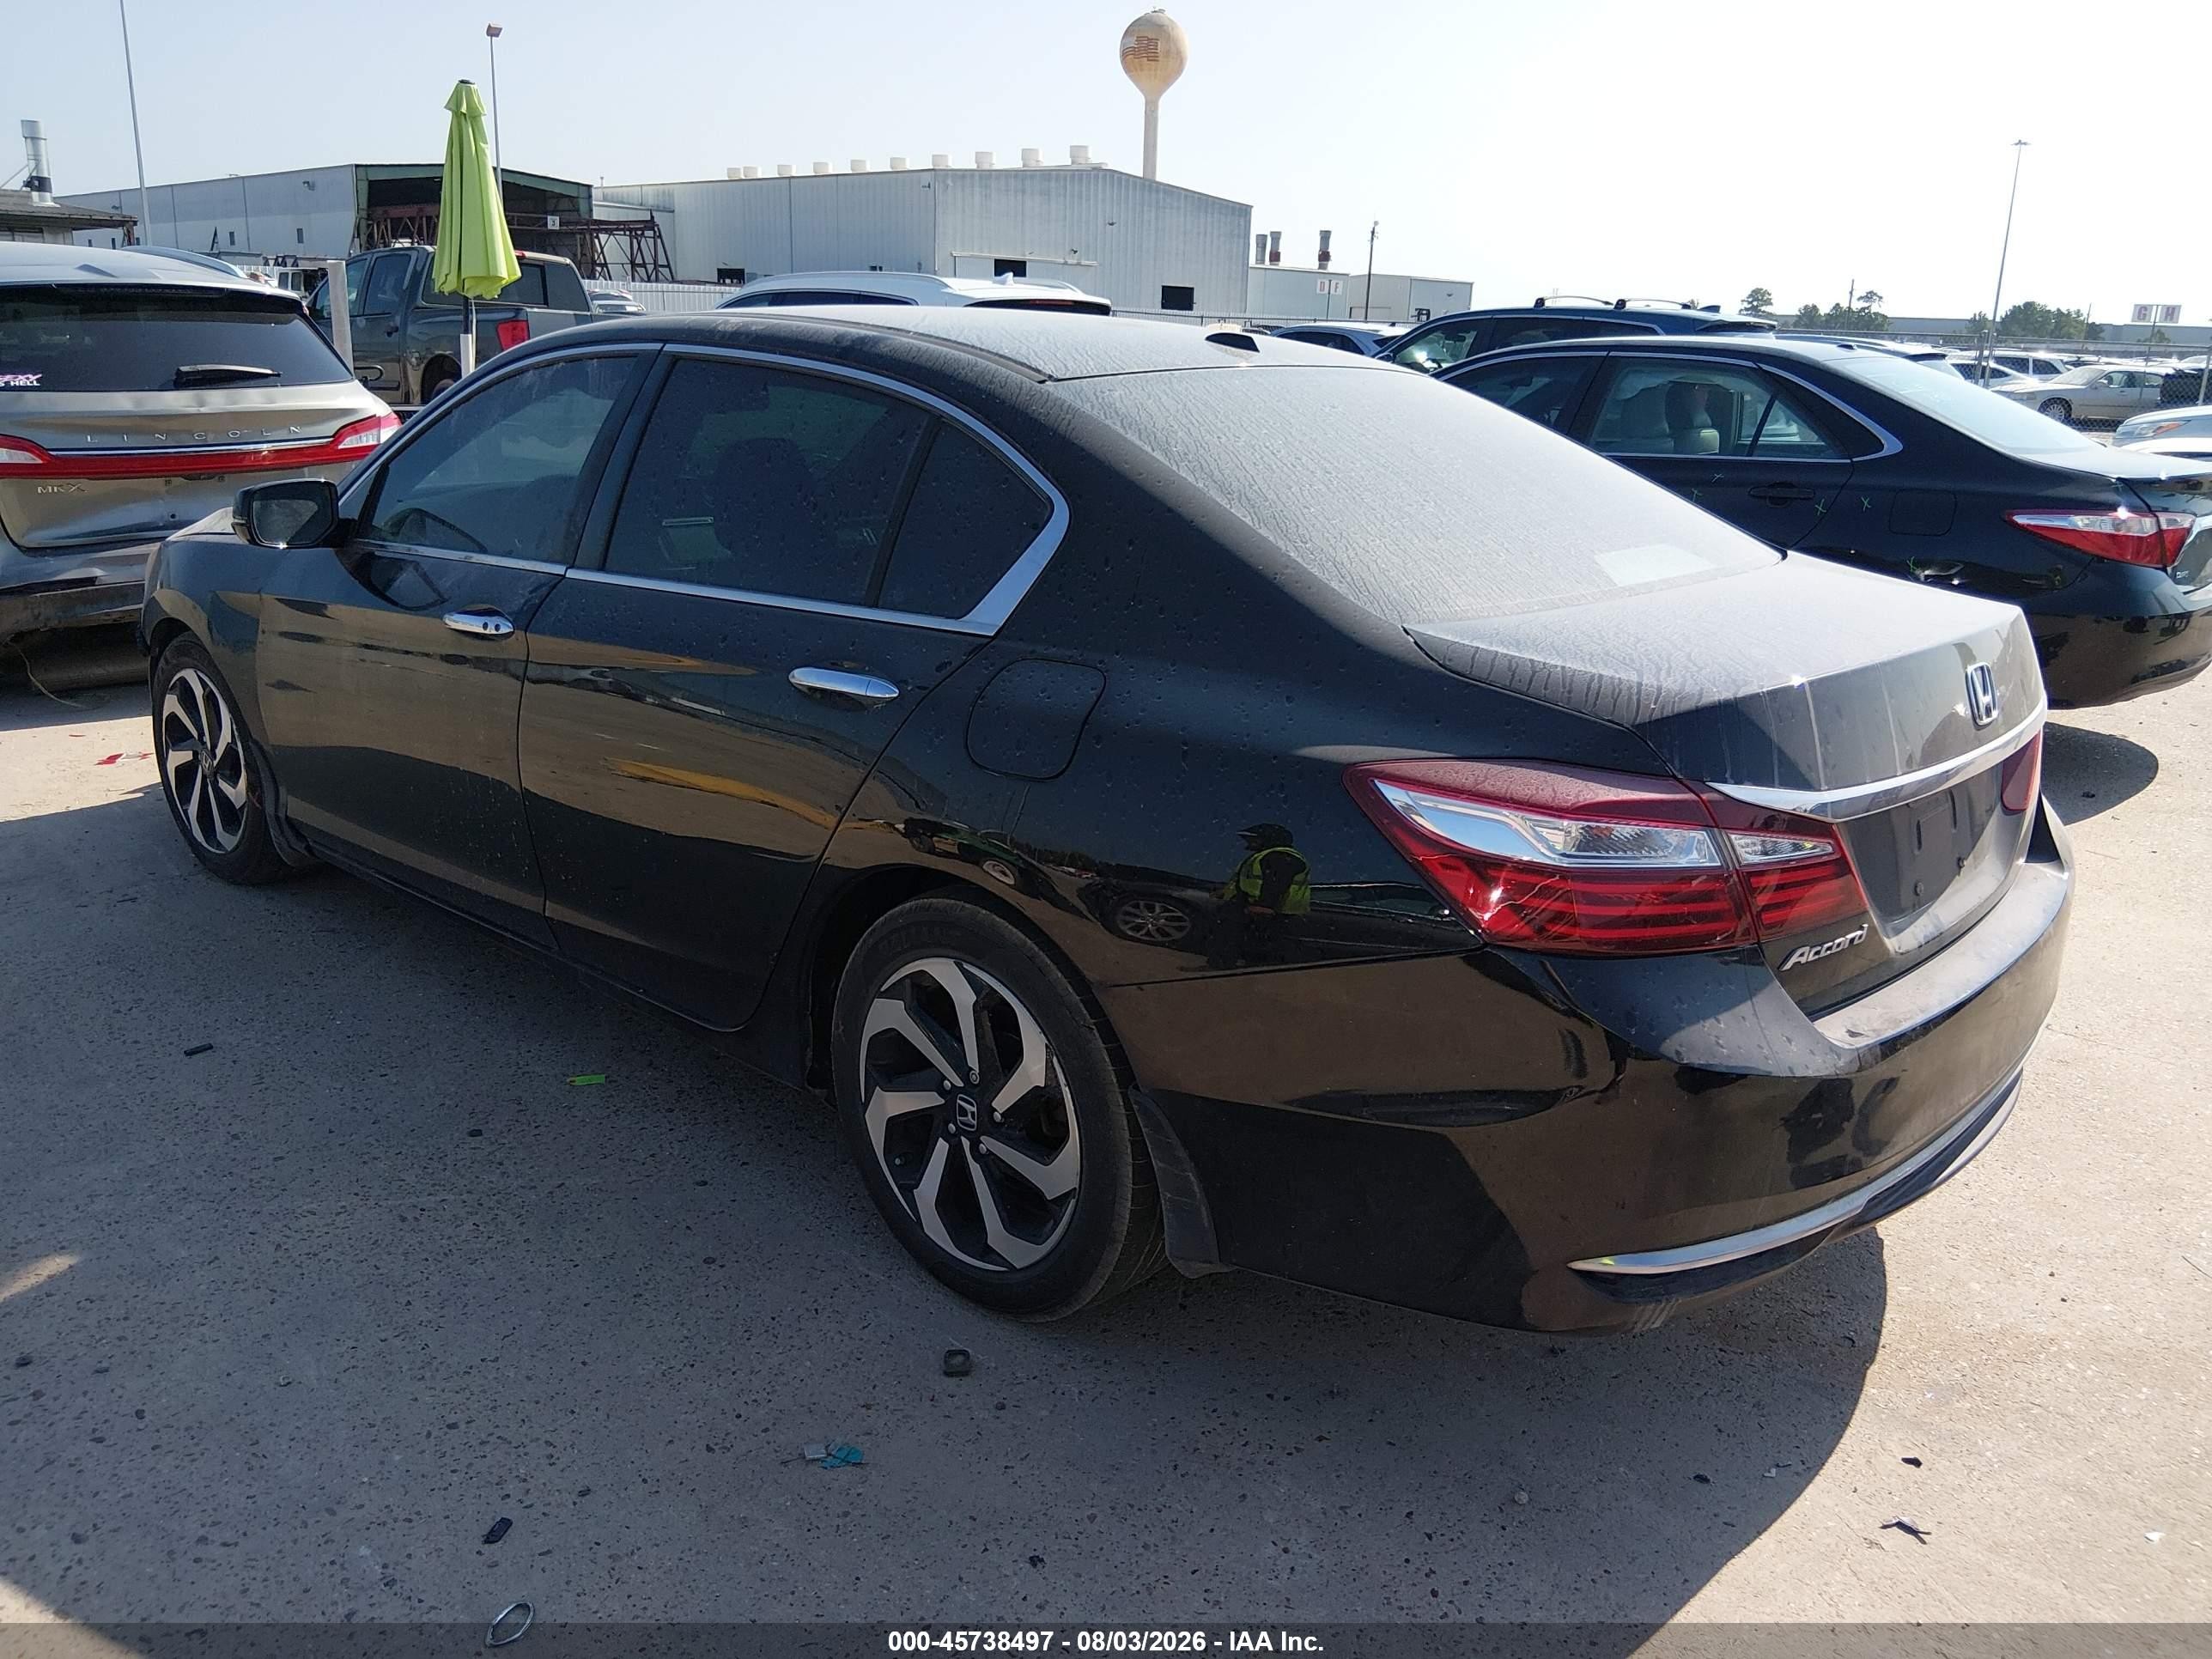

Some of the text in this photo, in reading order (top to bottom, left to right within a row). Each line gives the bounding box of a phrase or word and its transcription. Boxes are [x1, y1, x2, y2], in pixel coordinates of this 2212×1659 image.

[2163, 307, 2176, 321] H
[87, 425, 302, 442] LINCOLN
[37, 483, 87, 494] MKX
[1778, 923, 1869, 972] Accord
